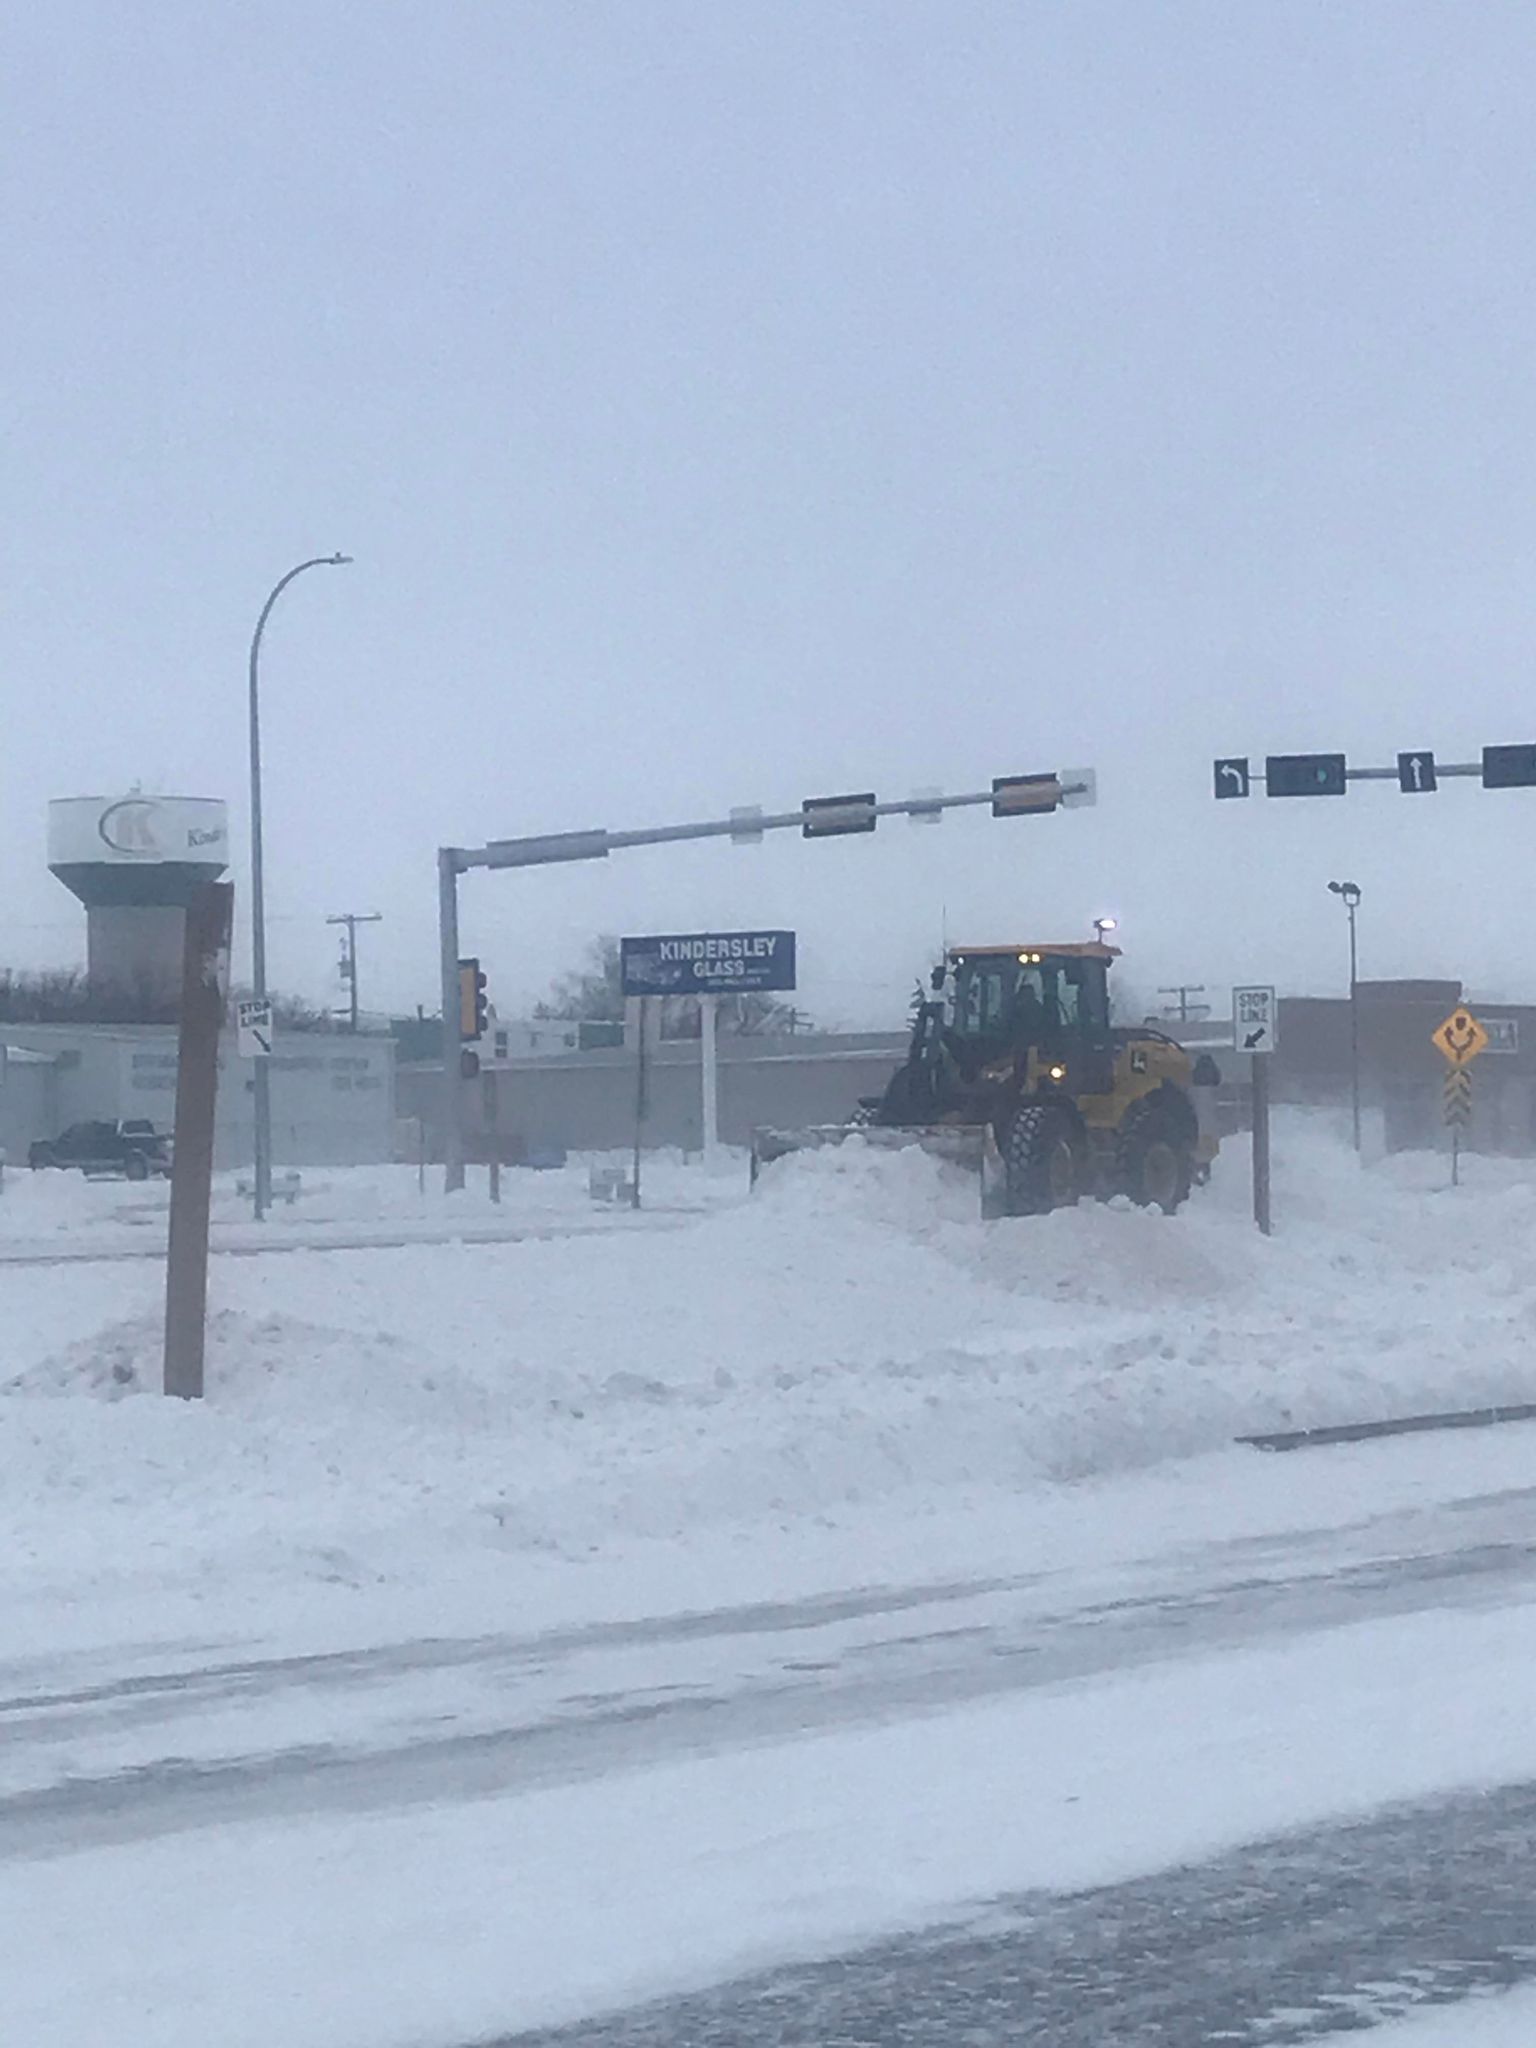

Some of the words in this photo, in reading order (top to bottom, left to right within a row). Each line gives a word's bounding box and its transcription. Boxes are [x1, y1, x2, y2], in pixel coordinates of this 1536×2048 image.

[660, 936, 777, 961] KINDERSLEY
[693, 960, 746, 978] GLASS
[1238, 991, 1269, 1008] STOP
[1240, 1007, 1269, 1023] LINE
